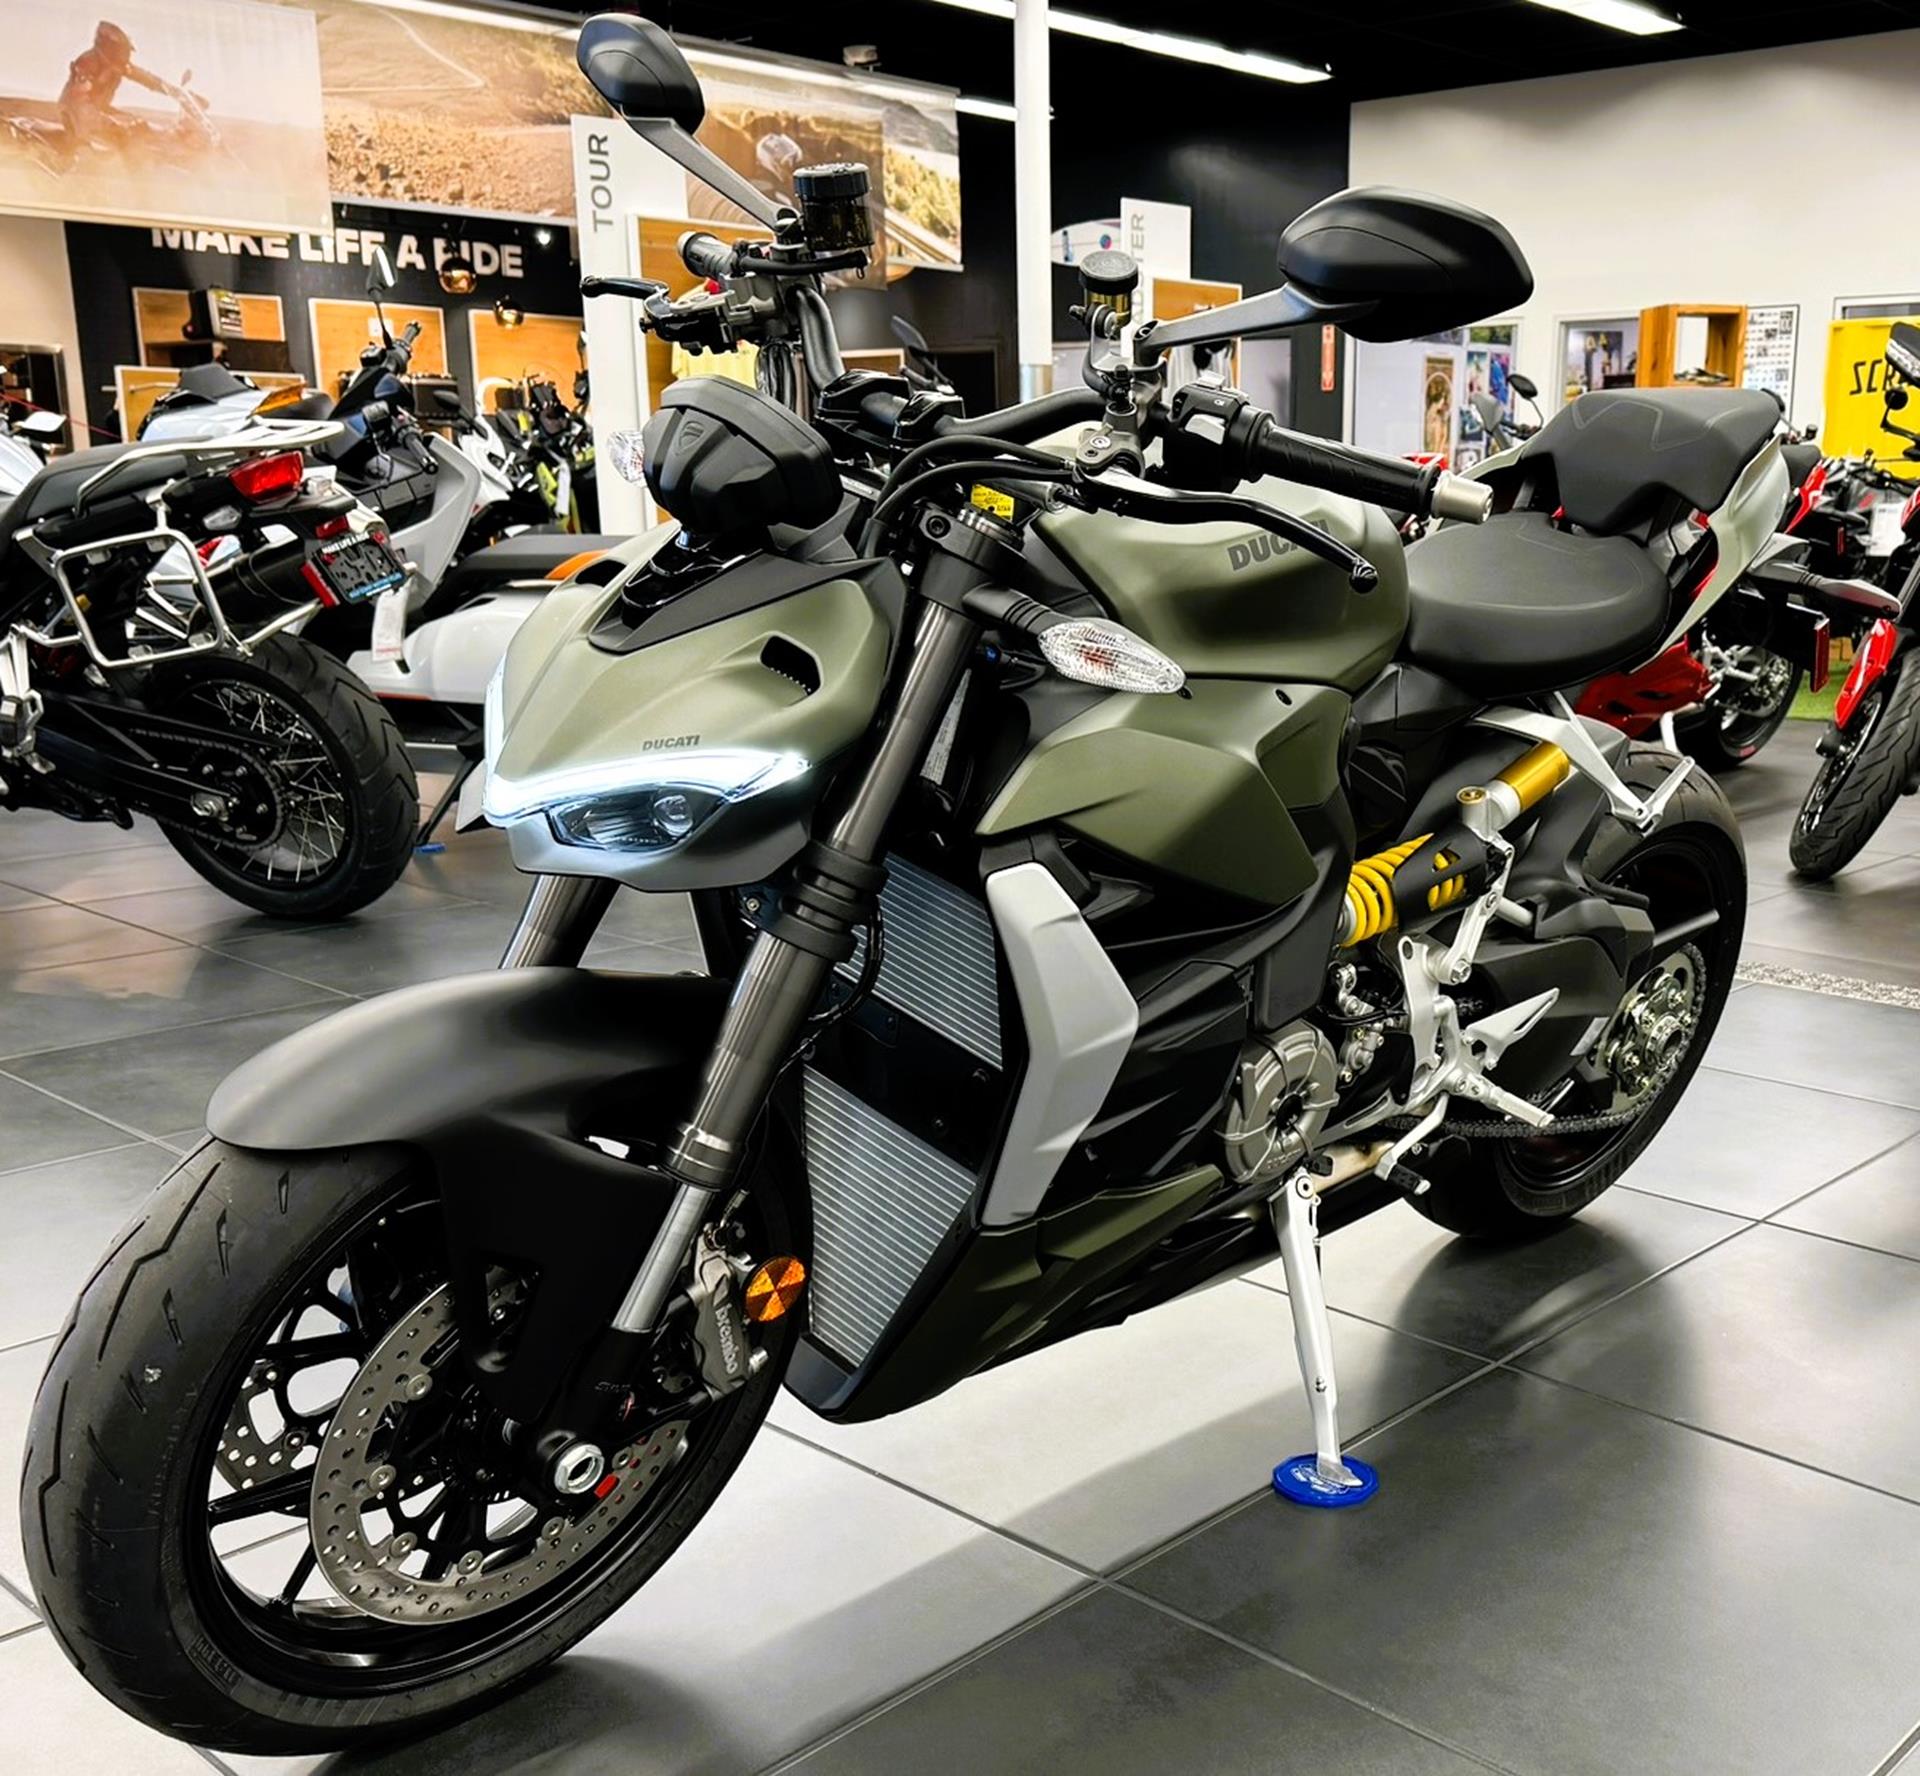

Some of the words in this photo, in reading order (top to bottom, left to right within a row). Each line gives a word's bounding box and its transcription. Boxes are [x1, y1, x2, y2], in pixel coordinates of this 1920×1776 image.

[588, 133, 614, 233] TOUR
[396, 234, 426, 270] A
[642, 735, 700, 751] DUCATI
[715, 1303, 739, 1374] brembo
